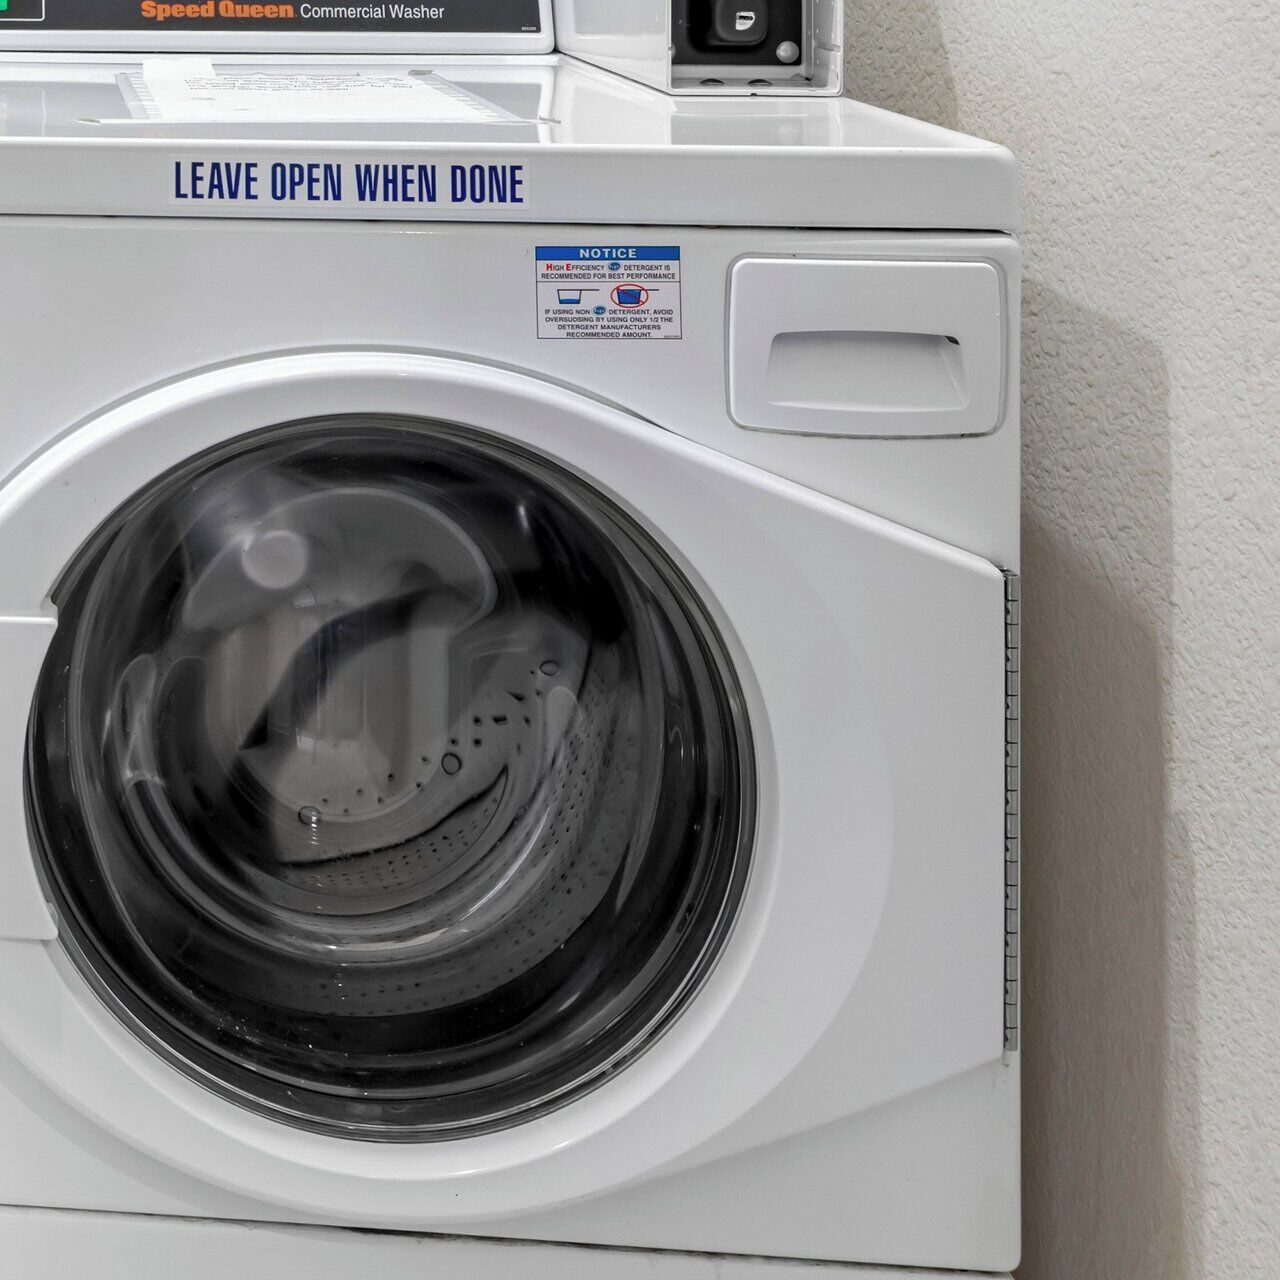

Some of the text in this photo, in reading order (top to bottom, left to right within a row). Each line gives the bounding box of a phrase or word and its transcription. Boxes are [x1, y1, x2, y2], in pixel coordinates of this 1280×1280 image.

[141, 0, 445, 21] Speed Queen Commercial Washer
[173, 160, 524, 204] LEAVE OPEN WHEN DONE
[579, 248, 638, 258] NOTICE
[626, 272, 676, 280] PERFORMANCE
